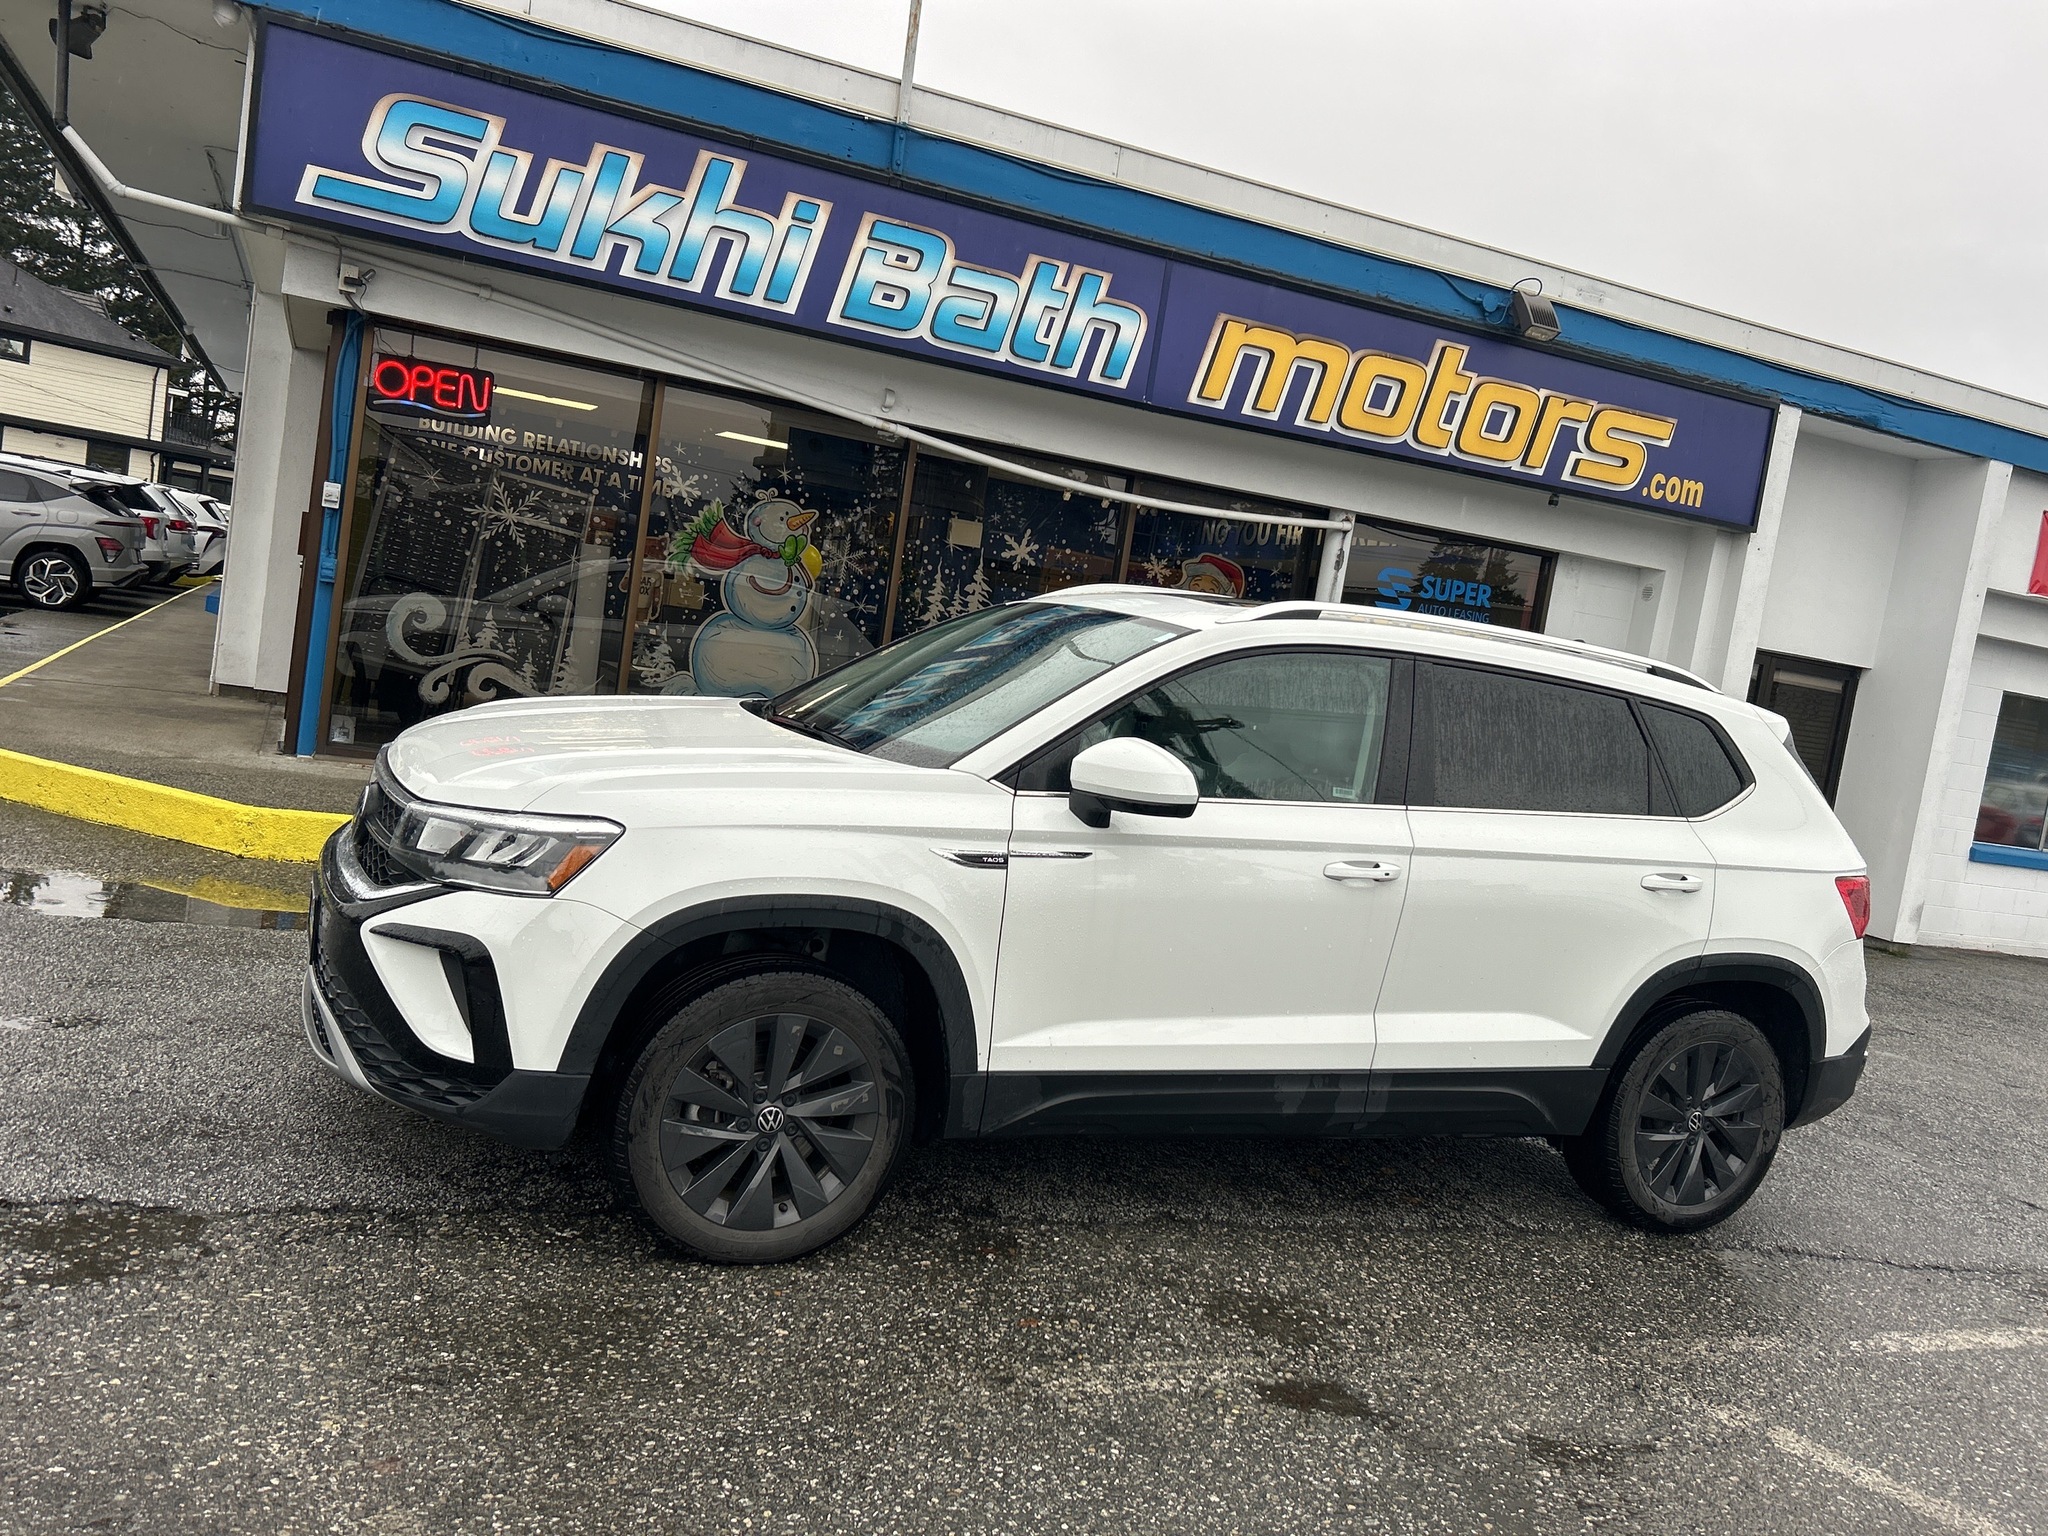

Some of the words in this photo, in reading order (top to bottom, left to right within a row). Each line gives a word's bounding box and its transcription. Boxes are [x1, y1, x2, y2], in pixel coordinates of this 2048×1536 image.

[296, 93, 833, 315] Sukhi
[826, 212, 1148, 389] Bath
[1187, 312, 1678, 491] motors
[1642, 473, 1704, 508] .com
[374, 360, 490, 412] OPEN
[419, 417, 517, 445] BUILDING
[523, 431, 672, 474] RELATIONSHPS
[579, 466, 604, 487] AT
[607, 472, 622, 489] A
[1235, 522, 1272, 546] YOU
[1420, 575, 1492, 609] SUPER
[1417, 603, 1447, 617] AUTO
[1448, 609, 1490, 624] LEASING
